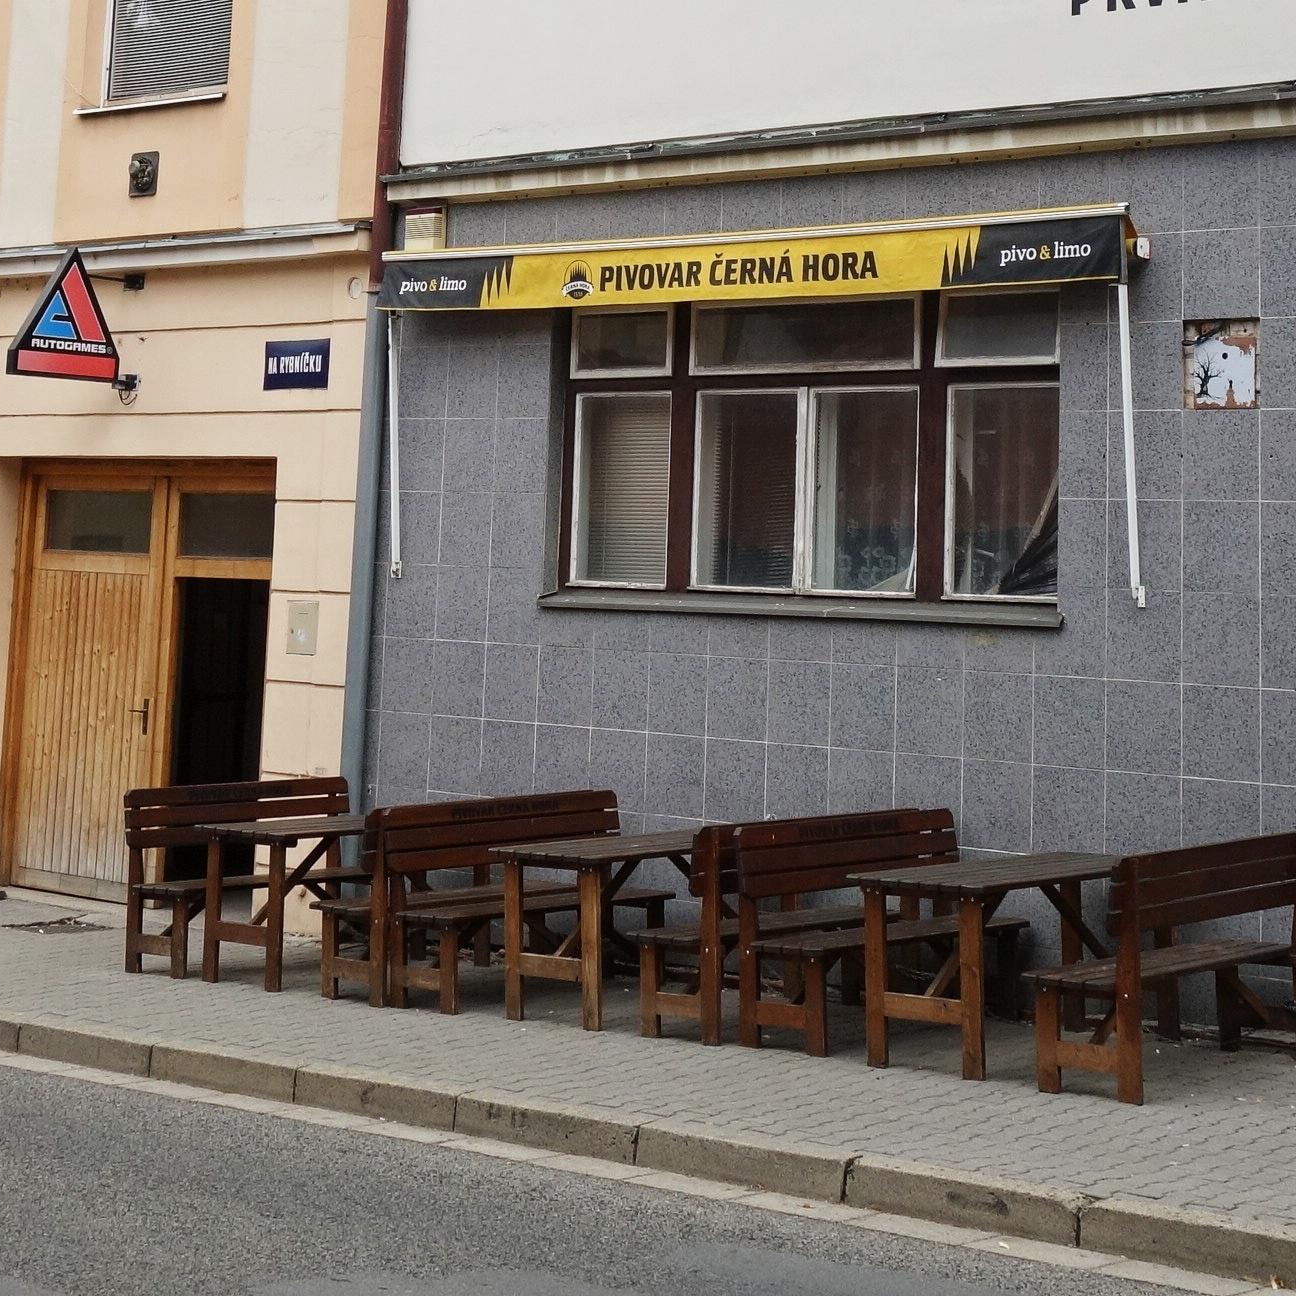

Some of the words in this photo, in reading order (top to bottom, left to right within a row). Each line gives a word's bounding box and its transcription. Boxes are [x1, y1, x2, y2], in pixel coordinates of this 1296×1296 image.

[999, 244, 1038, 267] pivo
[1039, 245, 1051, 260] &
[1053, 241, 1092, 259] limo
[599, 260, 703, 292] PIVOVAR
[709, 248, 794, 287] ČERNÁ
[802, 250, 880, 282] HORA
[399, 277, 428, 295] pivo
[428, 278, 438, 292] &
[438, 275, 467, 291] limo
[31, 338, 107, 354] AUTOGAMES
[267, 356, 278, 375] NA
[279, 351, 323, 374] RYBNÍČKU
